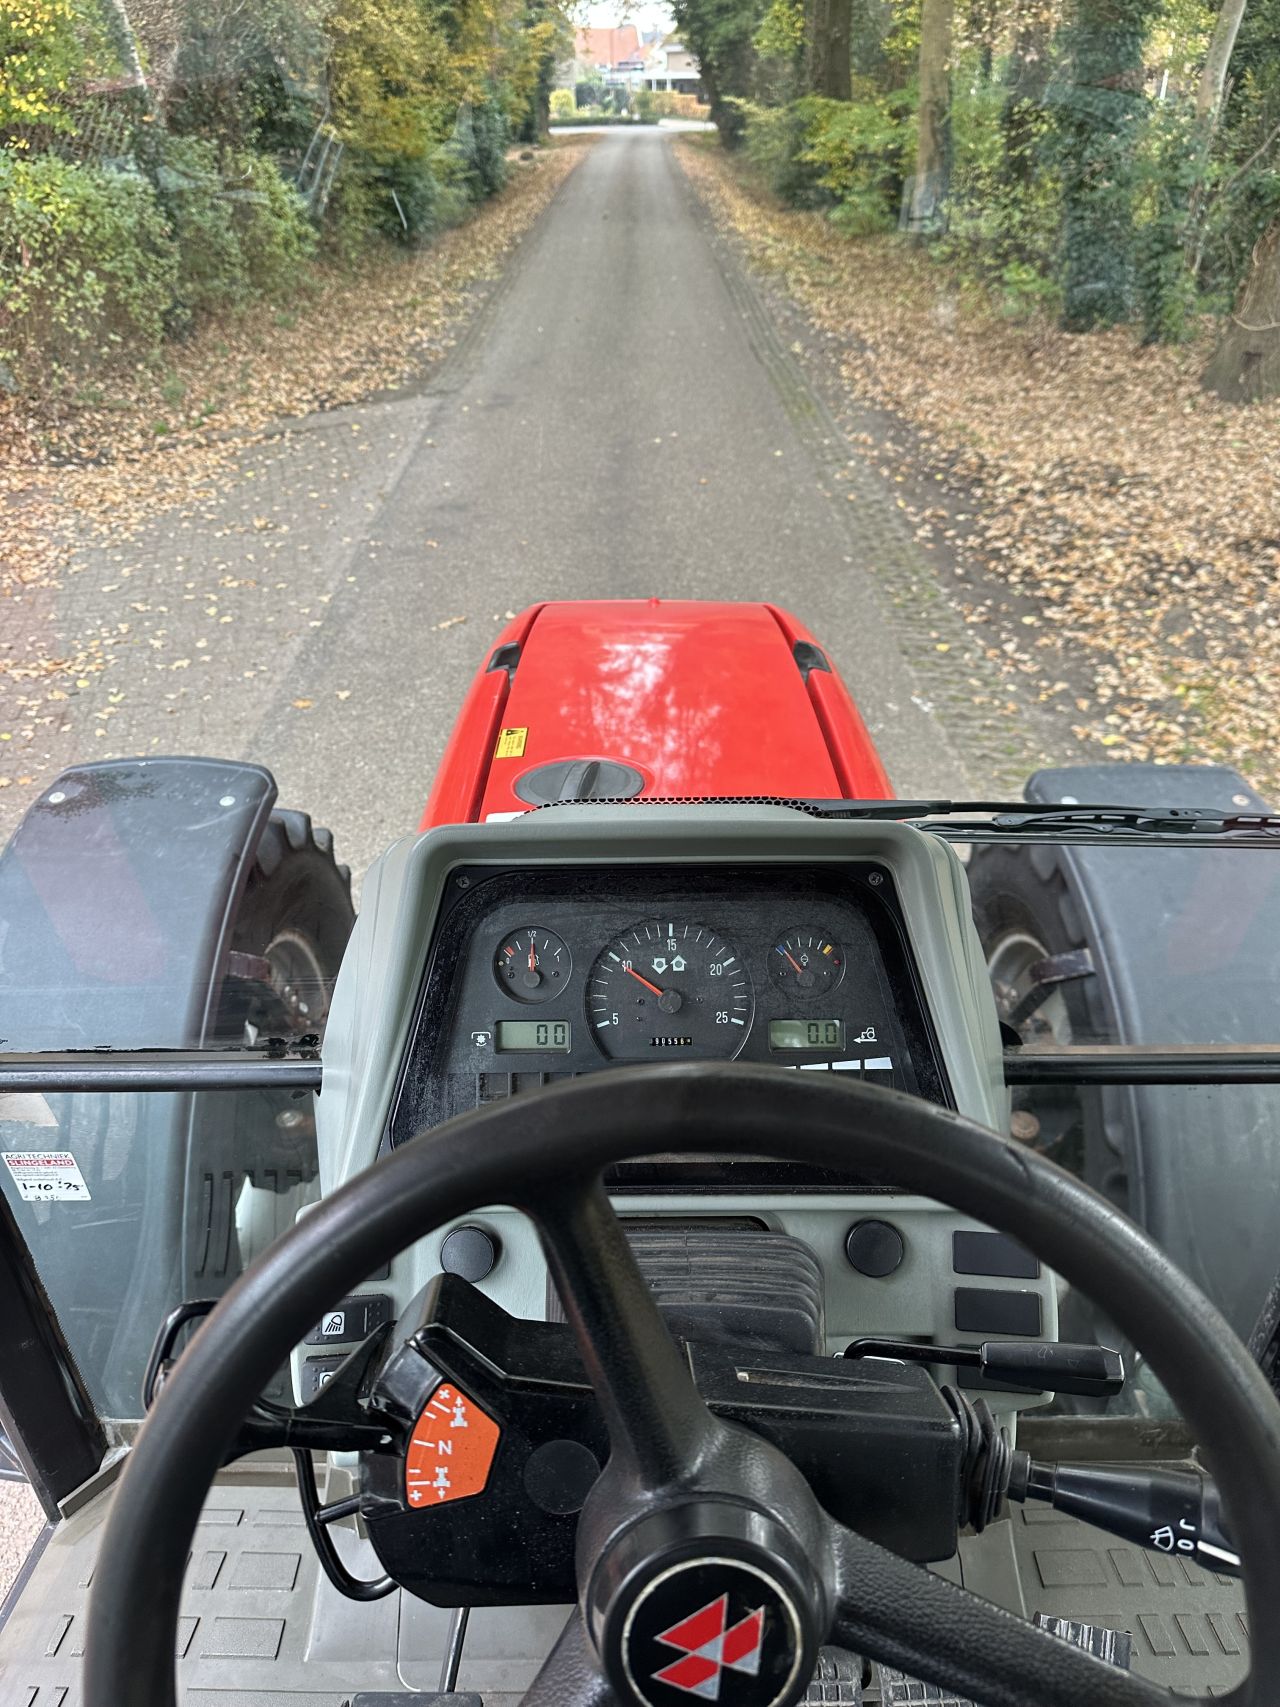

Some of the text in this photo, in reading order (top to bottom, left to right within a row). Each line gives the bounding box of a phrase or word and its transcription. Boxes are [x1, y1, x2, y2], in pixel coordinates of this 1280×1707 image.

[667, 939, 677, 951] 15
[621, 960, 633, 972] 10
[709, 963, 722, 976] 20
[612, 1012, 619, 1025] 5
[715, 1011, 728, 1024] 25
[807, 1022, 837, 1044] 0.0
[438, 1440, 452, 1455] N
